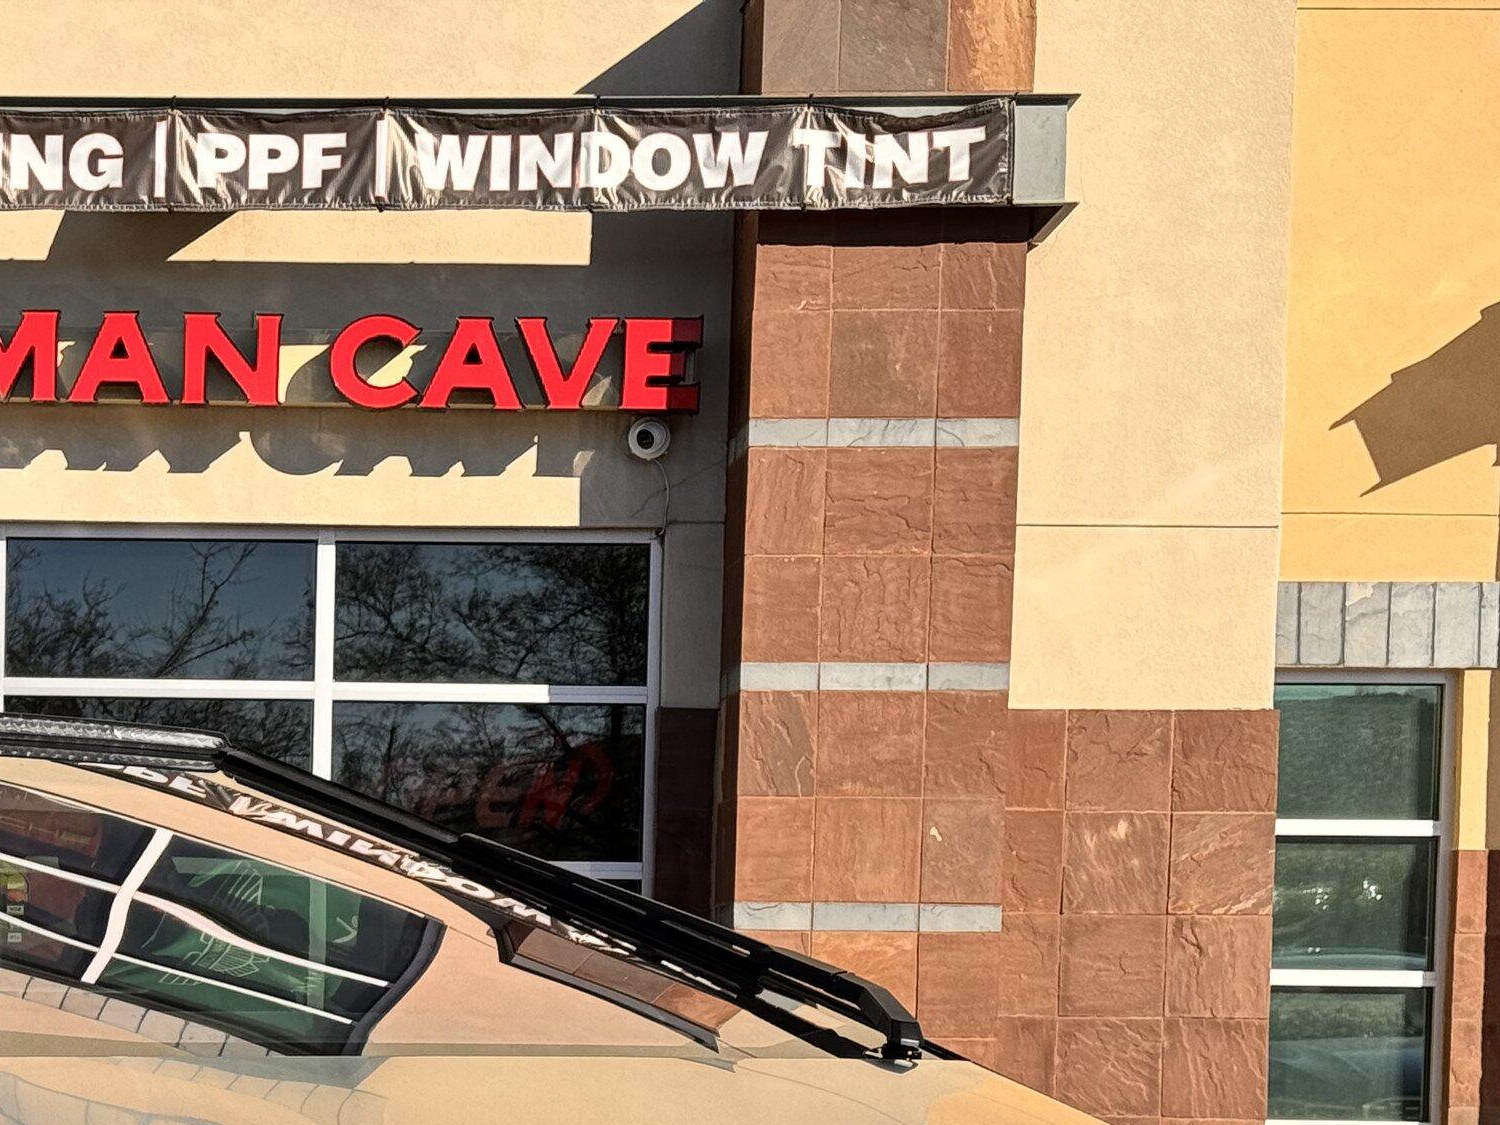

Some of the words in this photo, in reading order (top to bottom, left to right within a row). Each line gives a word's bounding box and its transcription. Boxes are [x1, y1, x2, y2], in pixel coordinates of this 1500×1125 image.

[197, 132, 348, 191] PPF
[417, 130, 768, 192] WINDOW
[792, 126, 988, 190] TINT
[328, 314, 702, 414] CAVE
